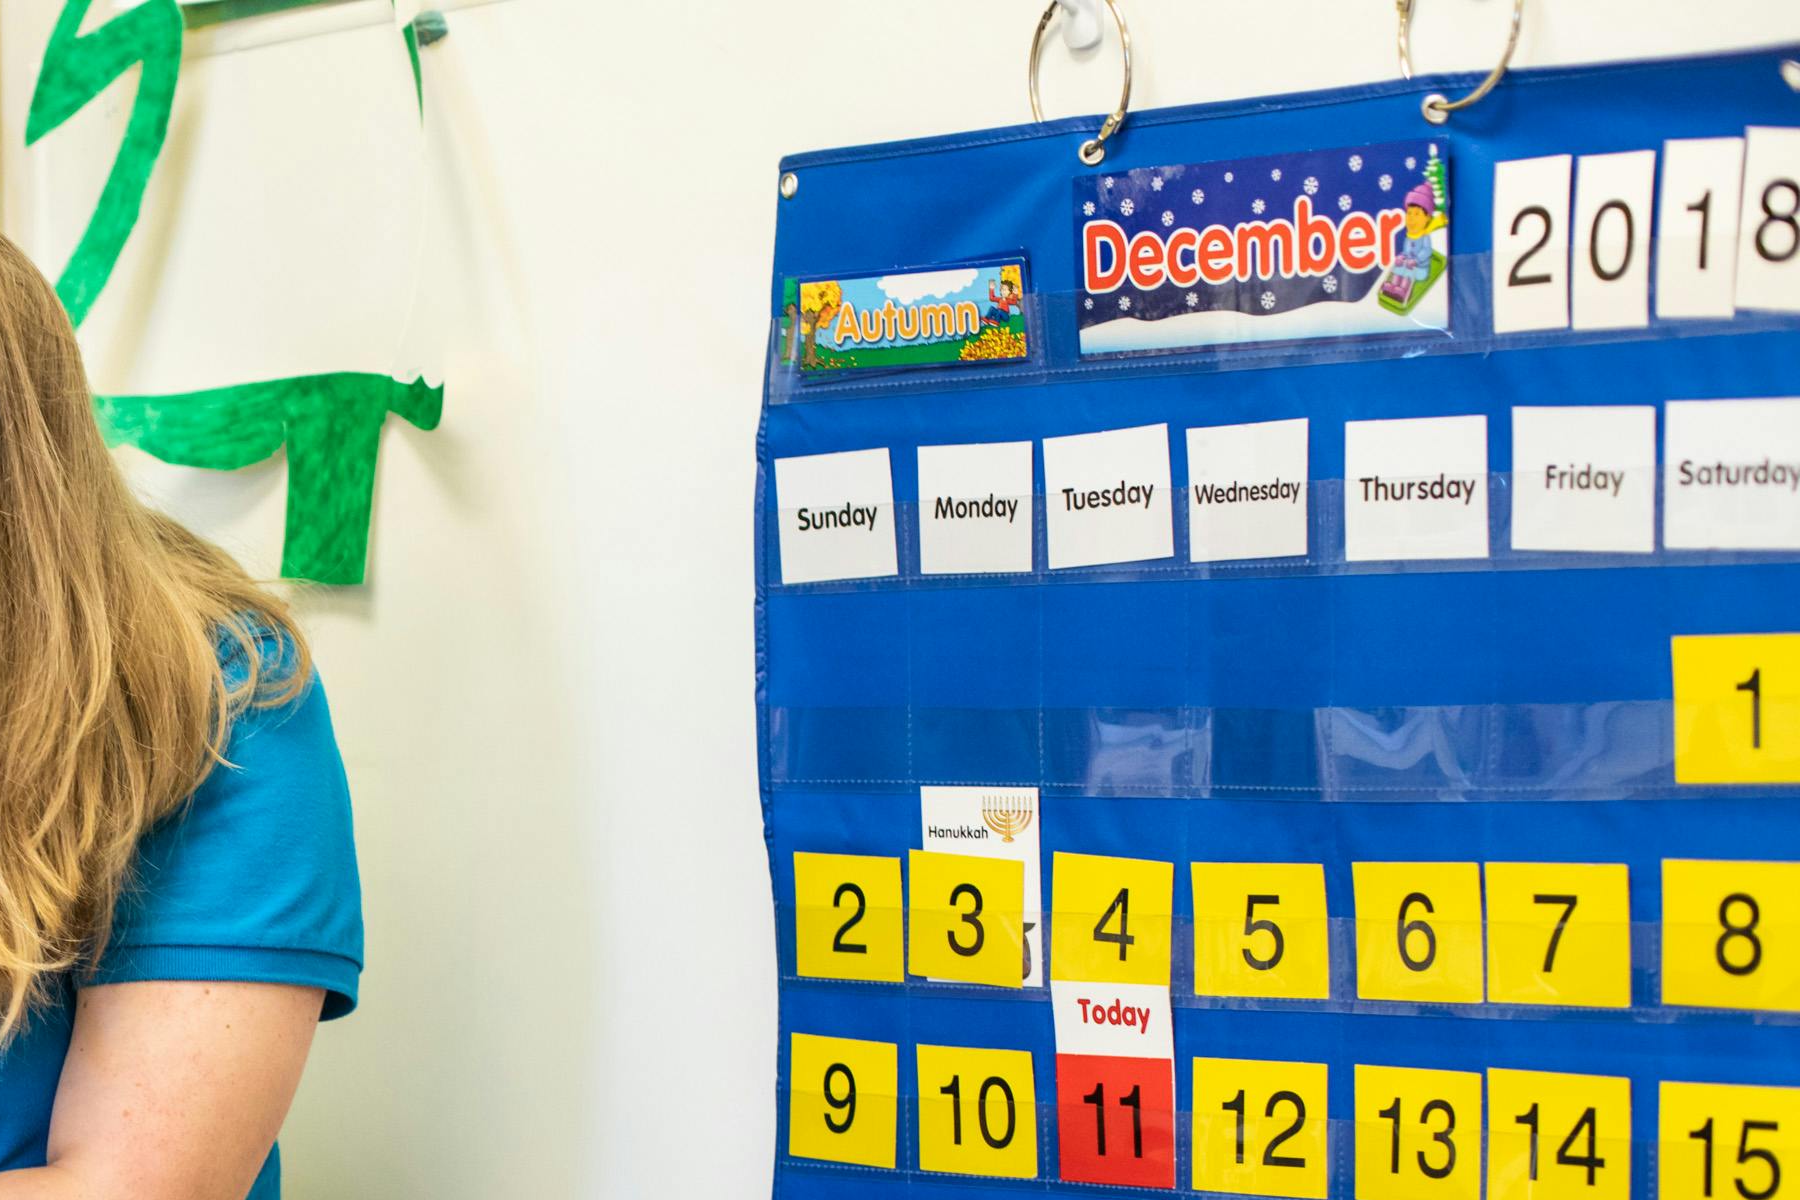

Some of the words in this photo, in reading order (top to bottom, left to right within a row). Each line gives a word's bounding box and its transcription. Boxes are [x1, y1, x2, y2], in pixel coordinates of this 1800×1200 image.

[1083, 195, 1404, 295] December
[1507, 178, 1800, 287] 2018
[834, 300, 981, 346] Autumn
[797, 501, 878, 532] Sunday
[934, 492, 1019, 524] Monday
[1061, 480, 1154, 512] Tuesday
[1194, 476, 1301, 505] Wednesday
[1359, 473, 1476, 505] Thursday
[1545, 463, 1625, 497] Friday
[1679, 459, 1800, 491] Saturday
[1736, 668, 1761, 749] 1
[928, 825, 988, 839] Hanukkah
[832, 882, 868, 955] 2
[947, 882, 985, 957] 3
[1093, 887, 1135, 962] 4
[1242, 894, 1285, 971] 5
[1397, 891, 1437, 972] 6
[1533, 894, 1578, 973] 7
[1715, 892, 1763, 977] 8
[1077, 998, 1151, 1035] Today
[823, 1062, 857, 1135] 9
[939, 1074, 1016, 1150] 10
[1083, 1082, 1143, 1159] 11
[1222, 1089, 1306, 1169] 12
[1378, 1097, 1457, 1180] 13
[1515, 1102, 1606, 1186] 14
